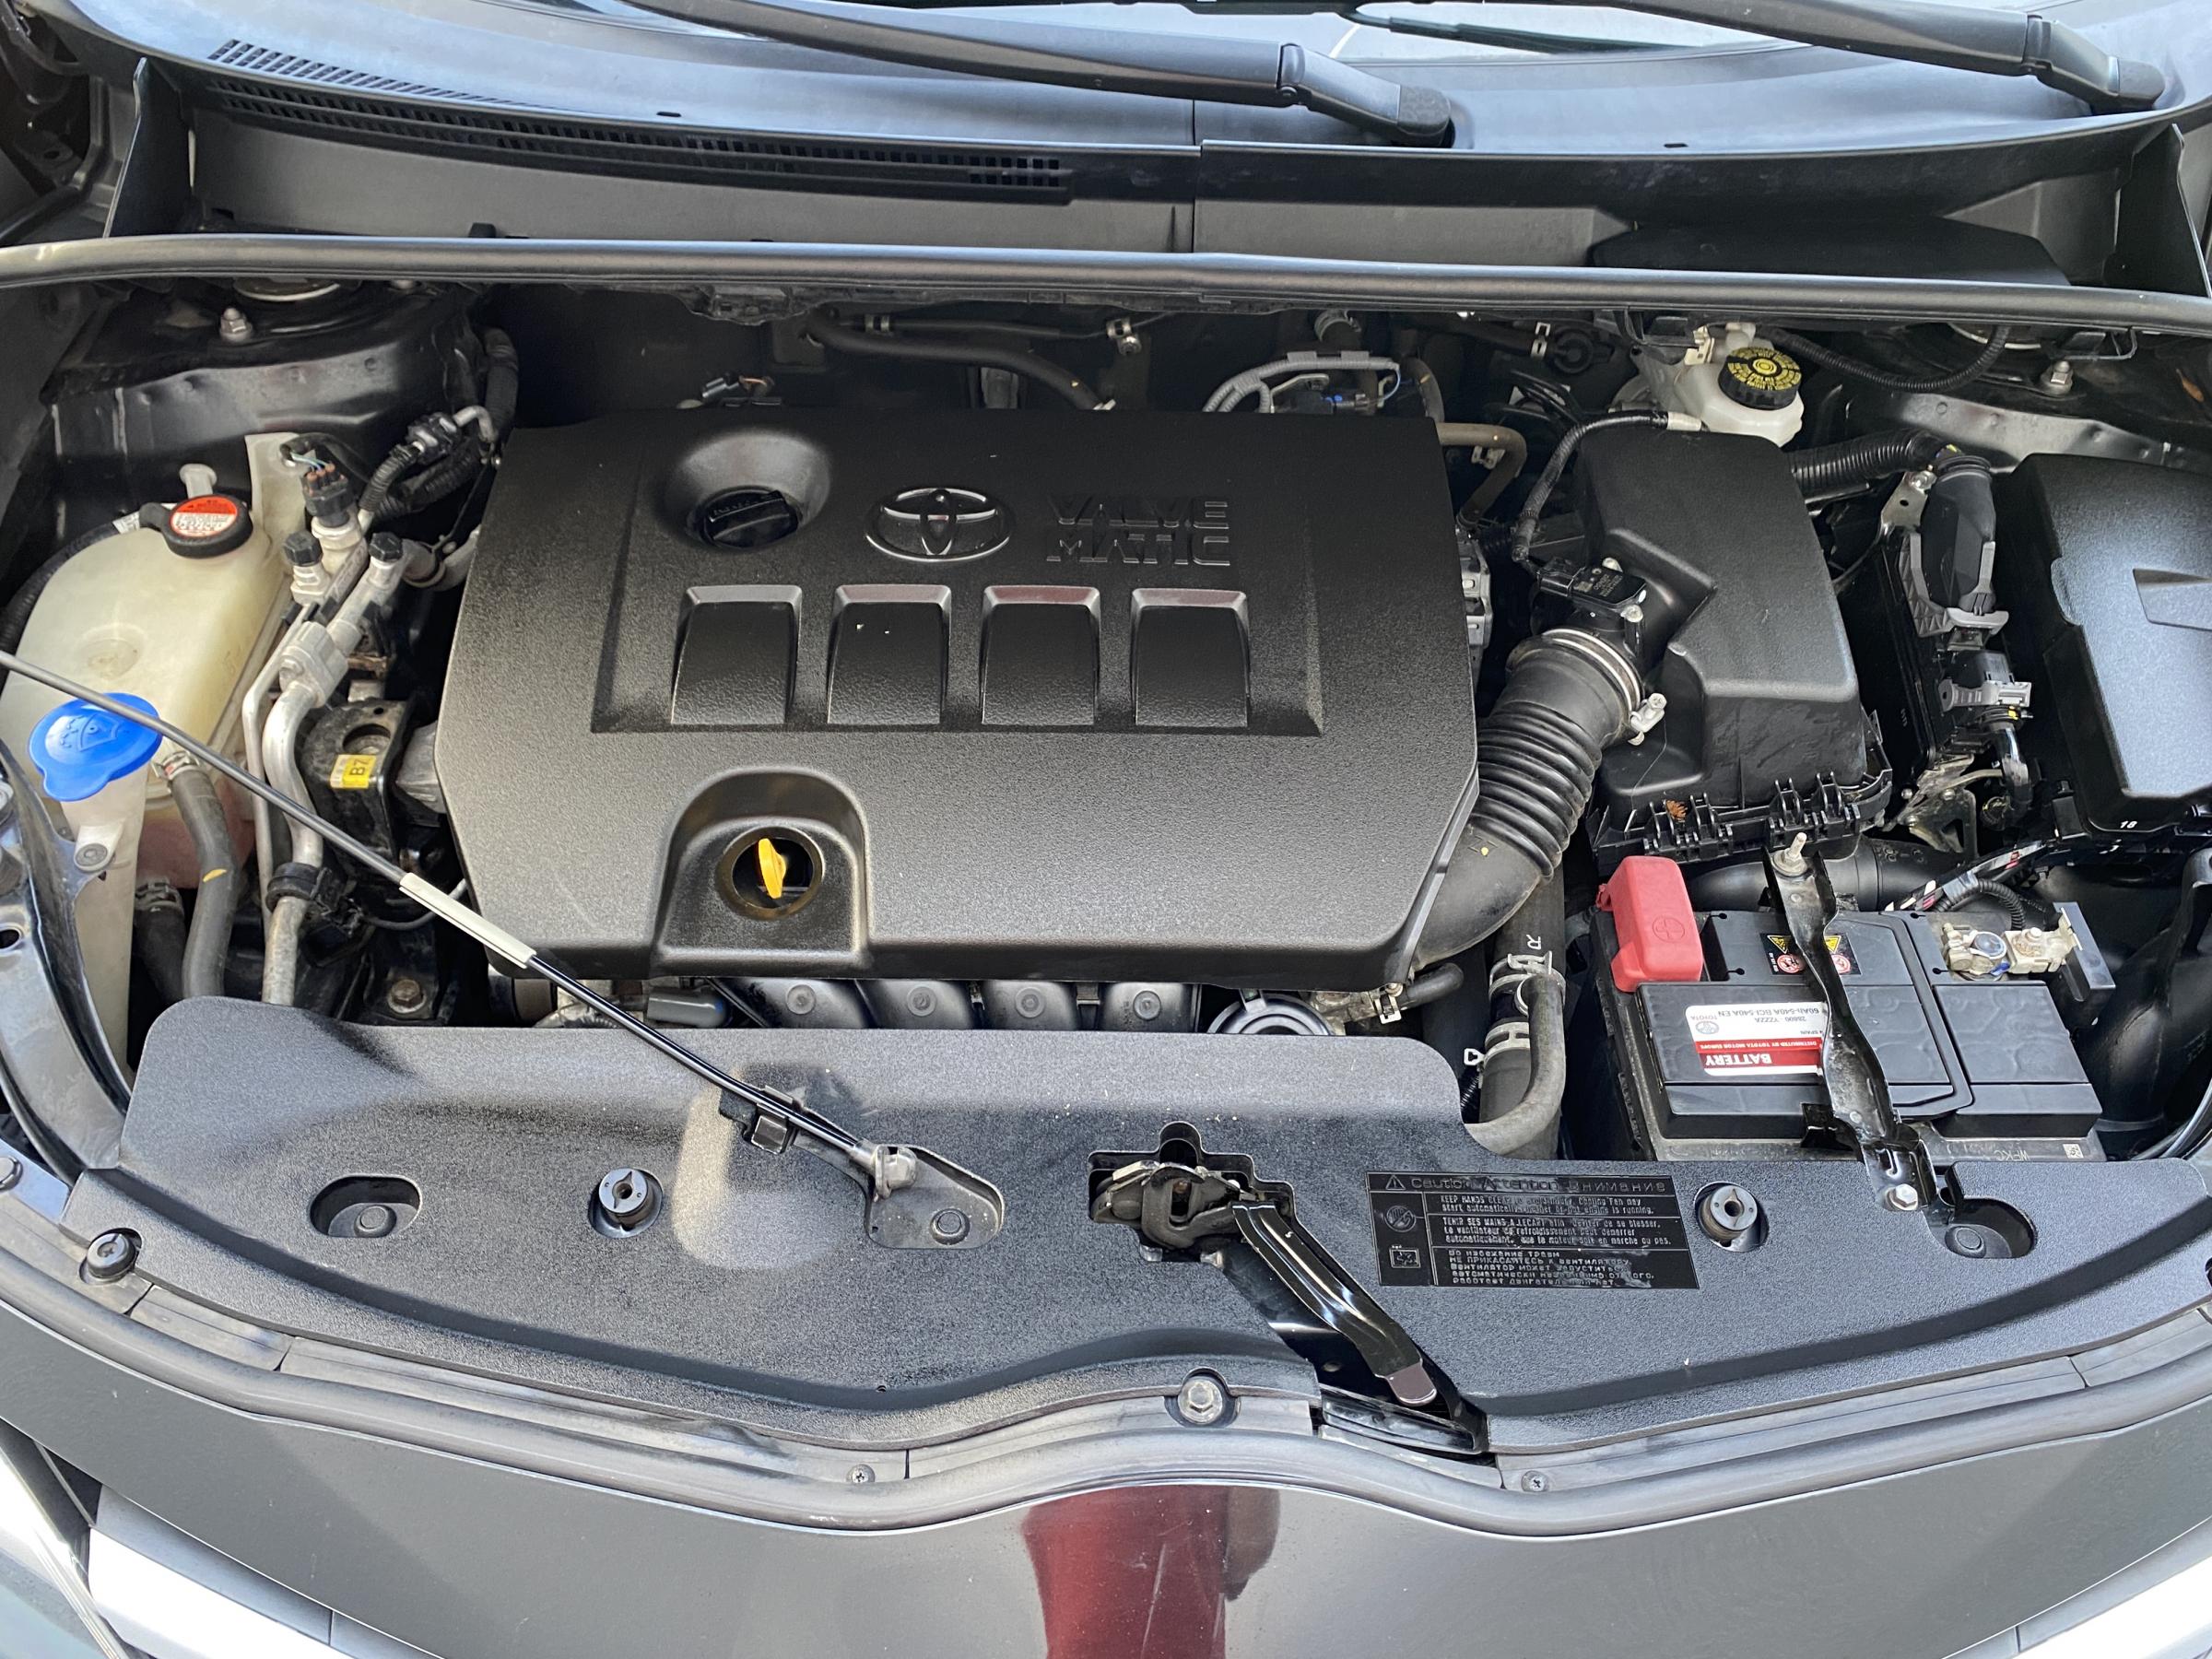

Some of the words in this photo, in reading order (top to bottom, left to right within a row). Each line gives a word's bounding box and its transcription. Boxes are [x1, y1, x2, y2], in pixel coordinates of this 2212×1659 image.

[1048, 493, 1230, 530] VALVE
[1045, 533, 1232, 567] MATIC
[2119, 819, 2139, 830] 18
[1779, 1041, 1818, 1049] DISTRIBUTED
[1704, 1053, 1772, 1066] BATTERY
[1410, 1177, 1472, 1190] Caution
[1481, 1177, 1558, 1191] Attention
[1568, 1180, 1666, 1193] Внимание
[1440, 1194, 1459, 1204] KEEP
